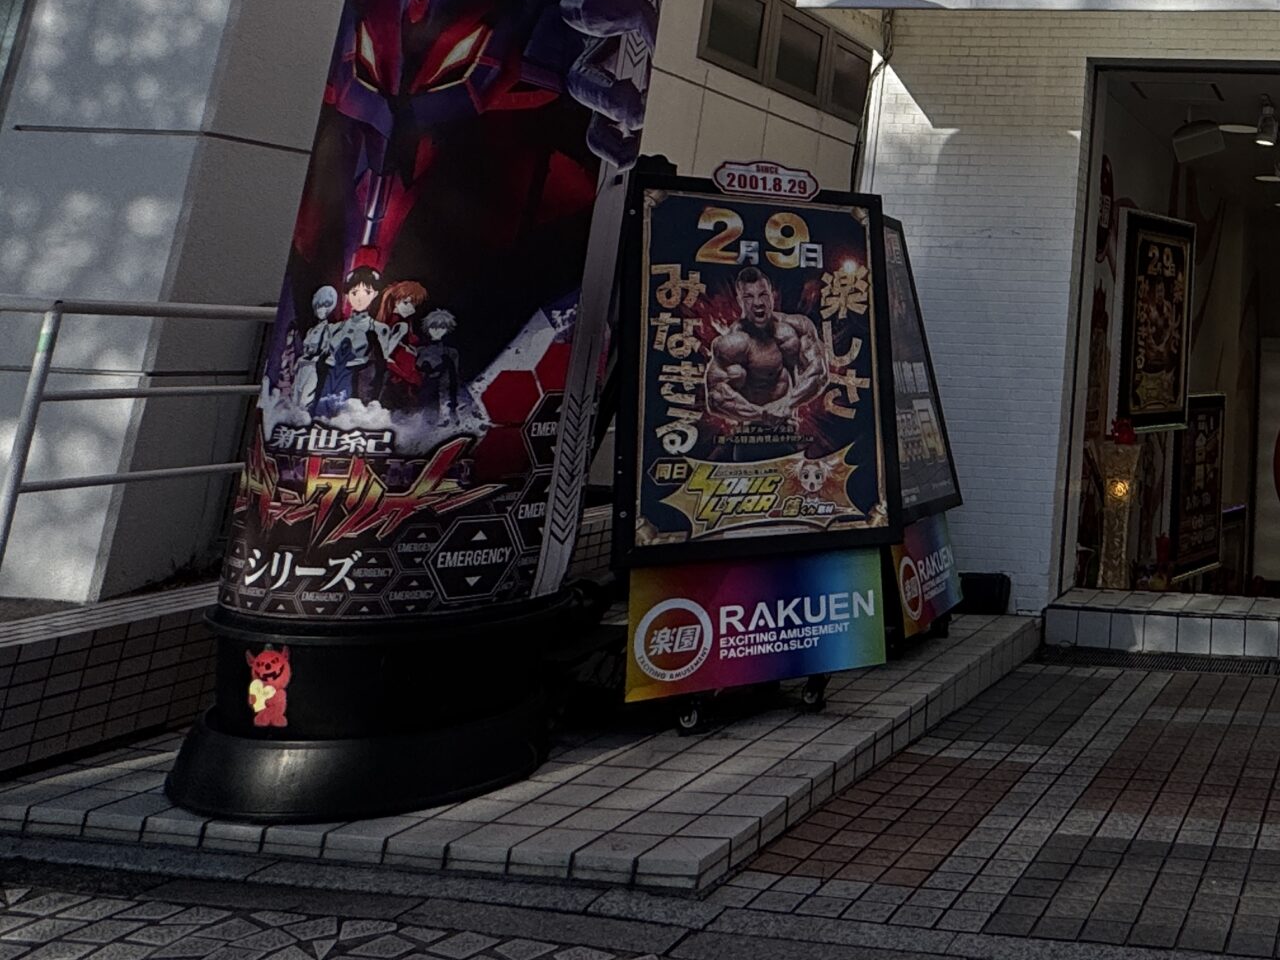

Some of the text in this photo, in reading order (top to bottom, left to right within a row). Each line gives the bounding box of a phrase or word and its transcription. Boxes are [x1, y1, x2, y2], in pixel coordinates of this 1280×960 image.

[727, 172, 808, 195] 2001.8.29
[695, 206, 823, 269] 2月9日
[819, 266, 871, 419] 楽しさ
[650, 263, 707, 457] みなぎる
[271, 423, 393, 455] 新世紀
[244, 548, 363, 592] シリーズ
[436, 546, 513, 569] EMERGENCY
[719, 589, 876, 635] RAKUEN
[648, 624, 702, 657] 楽園
[719, 637, 820, 660] PACHINKO&SLOT
[720, 621, 850, 648] EXCITING AMUSEMENT
[669, 646, 709, 680] AMUSEMENT
